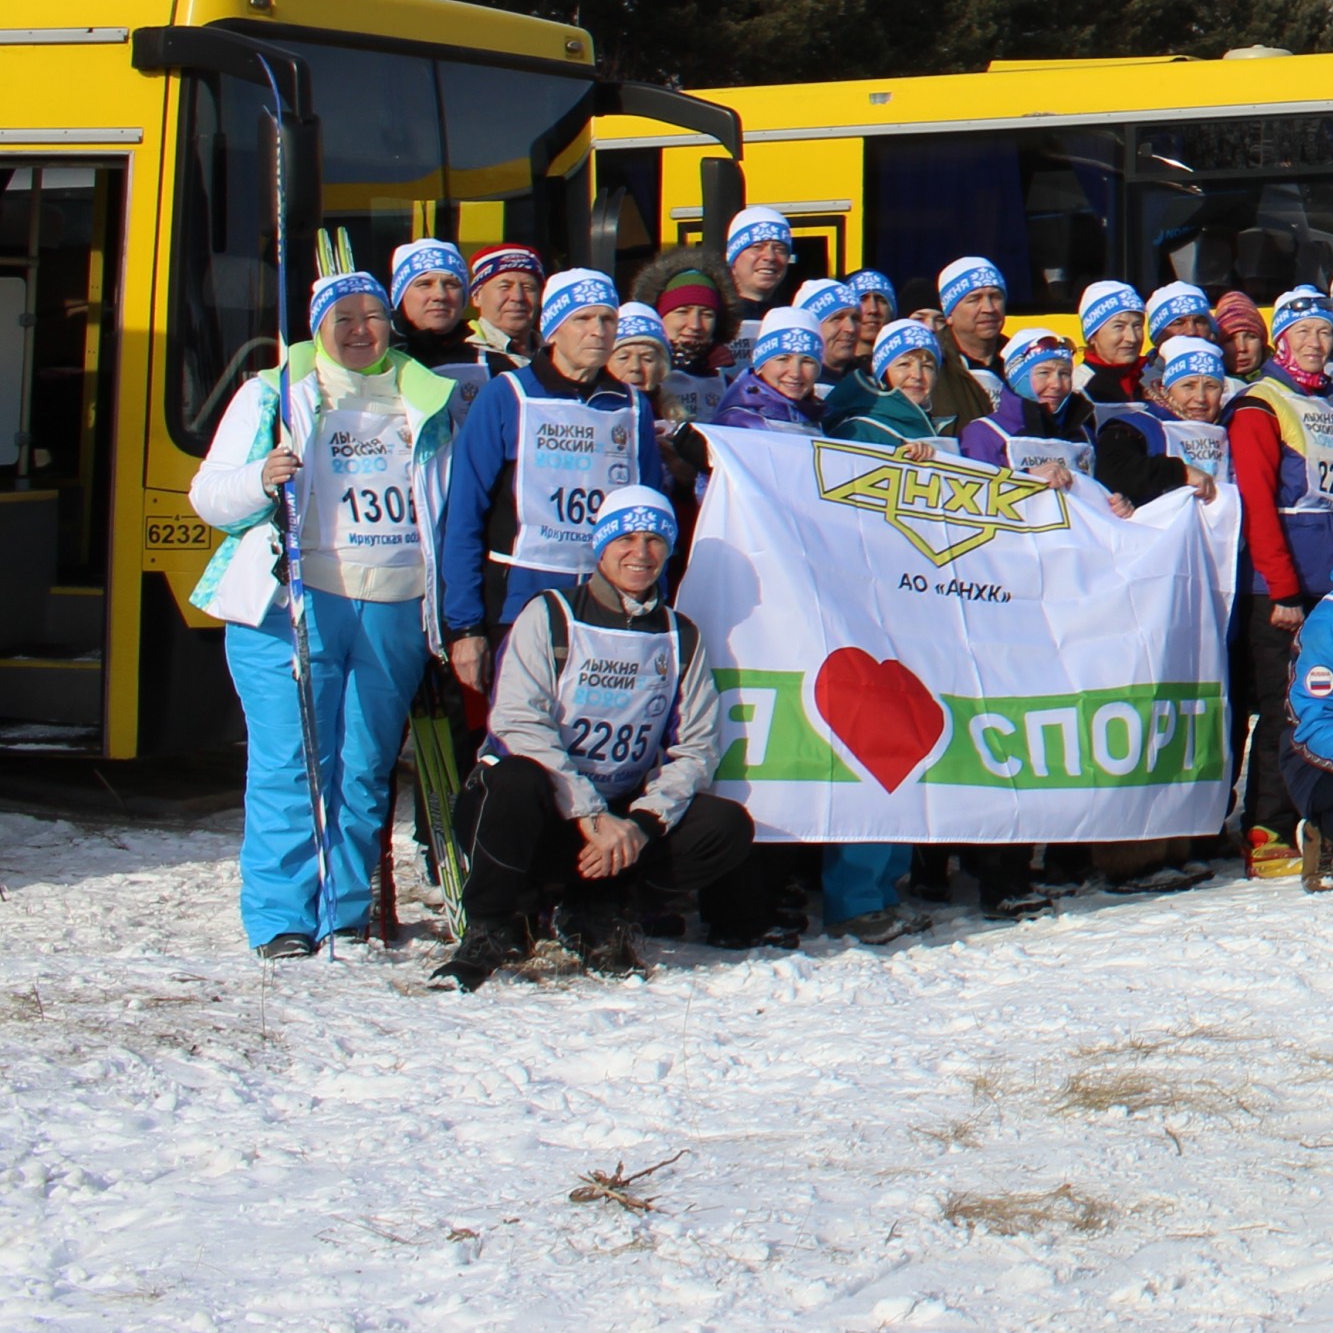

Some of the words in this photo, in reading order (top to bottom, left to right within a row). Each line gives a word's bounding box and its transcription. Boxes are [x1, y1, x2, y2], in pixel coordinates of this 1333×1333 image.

[537, 423, 594, 439] ЛЫЖНЯ
[536, 437, 594, 453] РОССИИ
[331, 457, 388, 474] 2020
[534, 453, 592, 471] 2020
[822, 465, 1055, 523] АНХК
[288, 490, 300, 550] NORDWAY
[148, 524, 206, 544] 6232
[348, 532, 401, 545] Иркутская
[540, 526, 593, 542] Иркутская
[898, 571, 930, 594] АО
[934, 578, 1013, 605] «АНХК»
[580, 659, 639, 675] ЛЫЖНЯ
[577, 673, 636, 690] РОССИИ
[574, 689, 632, 709] 2020
[567, 717, 652, 763] 2285
[718, 687, 778, 767] Я
[967, 698, 1207, 779] СПОРТ
